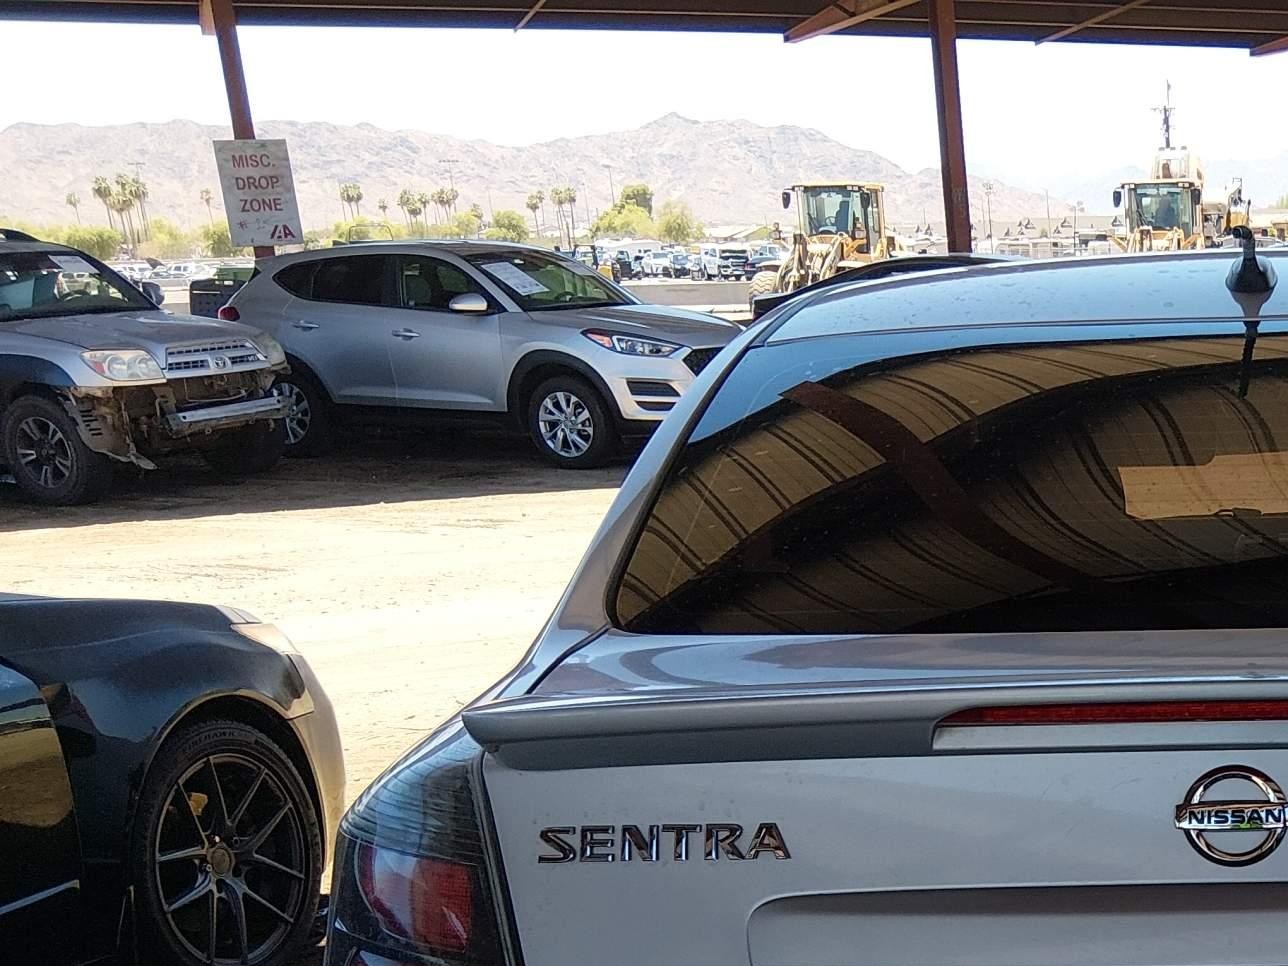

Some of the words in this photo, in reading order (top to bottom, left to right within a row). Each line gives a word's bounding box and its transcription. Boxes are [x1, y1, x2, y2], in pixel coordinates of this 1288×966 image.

[232, 154, 276, 168] MISC.
[235, 176, 280, 190] DROP
[240, 198, 284, 212] ZONE
[1188, 808, 1282, 824] NISSAN
[538, 823, 792, 863] SENTRA
